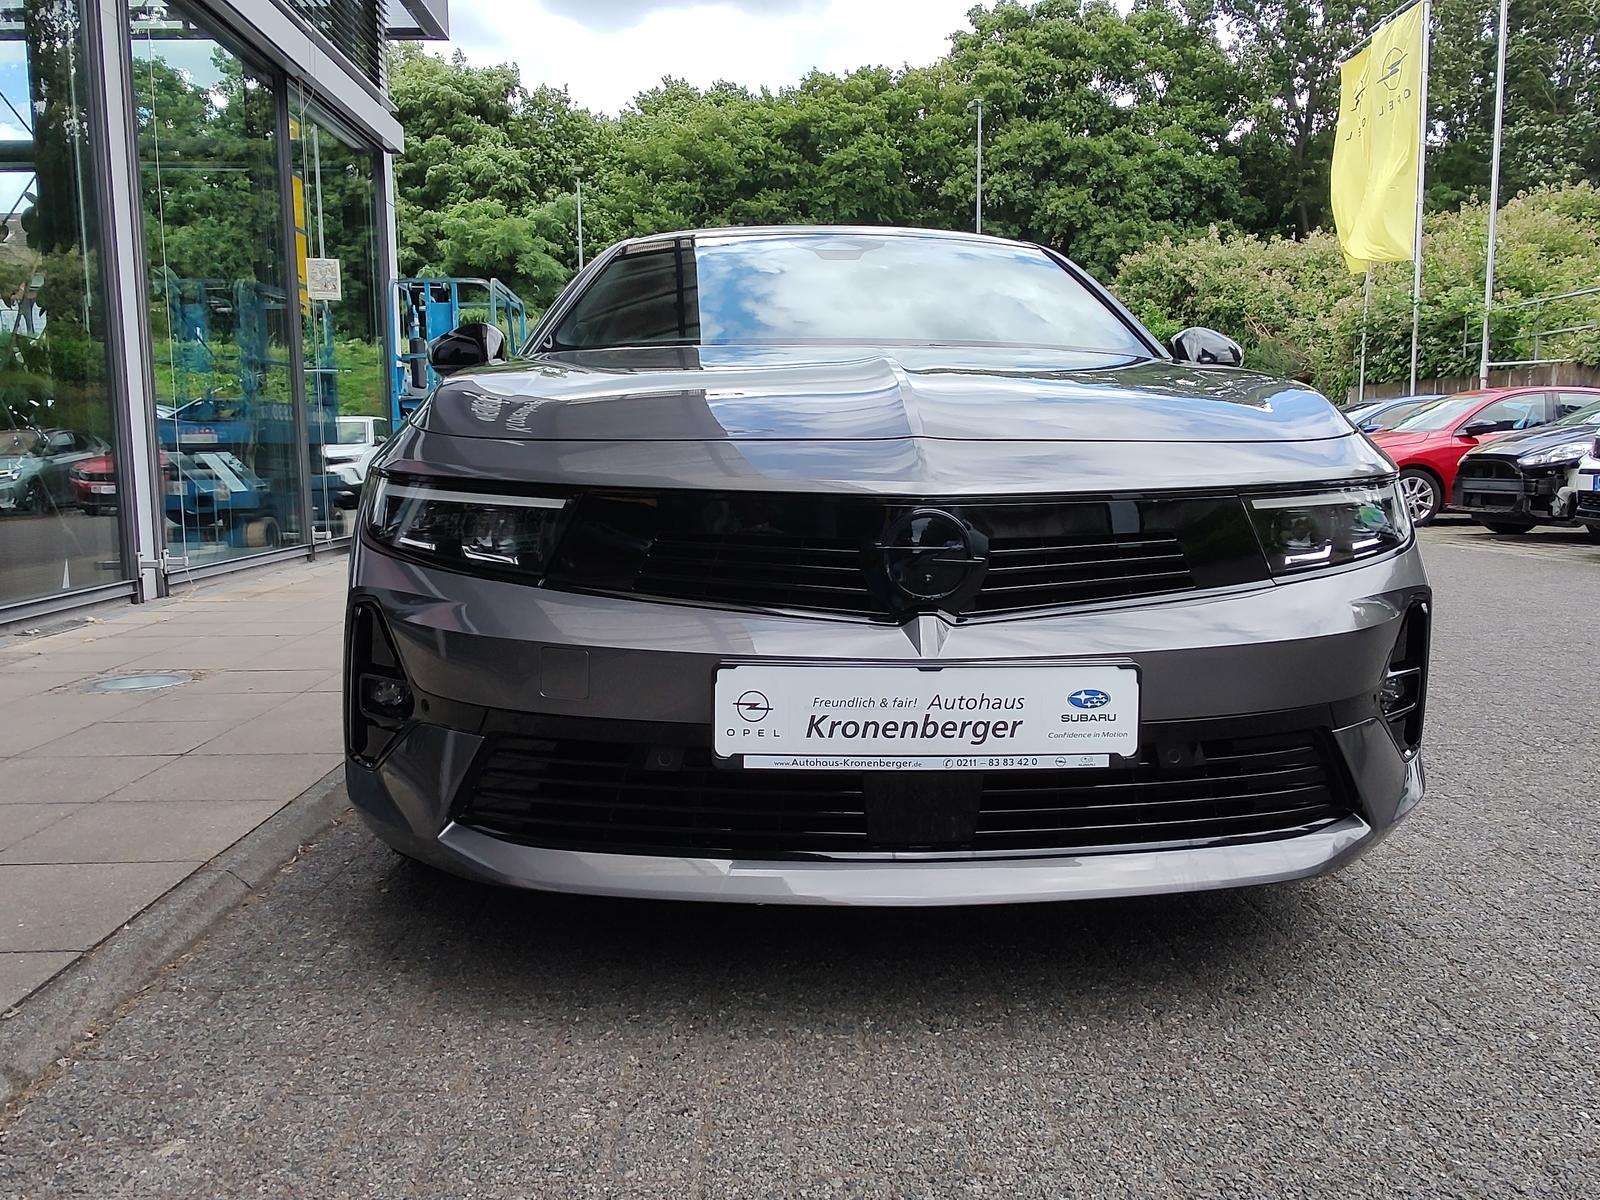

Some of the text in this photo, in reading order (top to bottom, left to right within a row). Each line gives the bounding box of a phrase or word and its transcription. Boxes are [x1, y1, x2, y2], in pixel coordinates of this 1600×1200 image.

[812, 697, 918, 709] Freundlich & fair!
[927, 693, 1025, 710] Autohaus
[1060, 713, 1117, 723] SUBARU
[726, 728, 780, 738] OPEL
[805, 713, 1024, 745] Kronenberger
[773, 757, 922, 769] www.Autohaus-Kronenberger.de
[956, 758, 977, 767] 0211
[988, 758, 1000, 767] 83
[1002, 758, 1014, 767] 83
[1017, 758, 1029, 767] 42
[1031, 757, 1038, 766] 0
